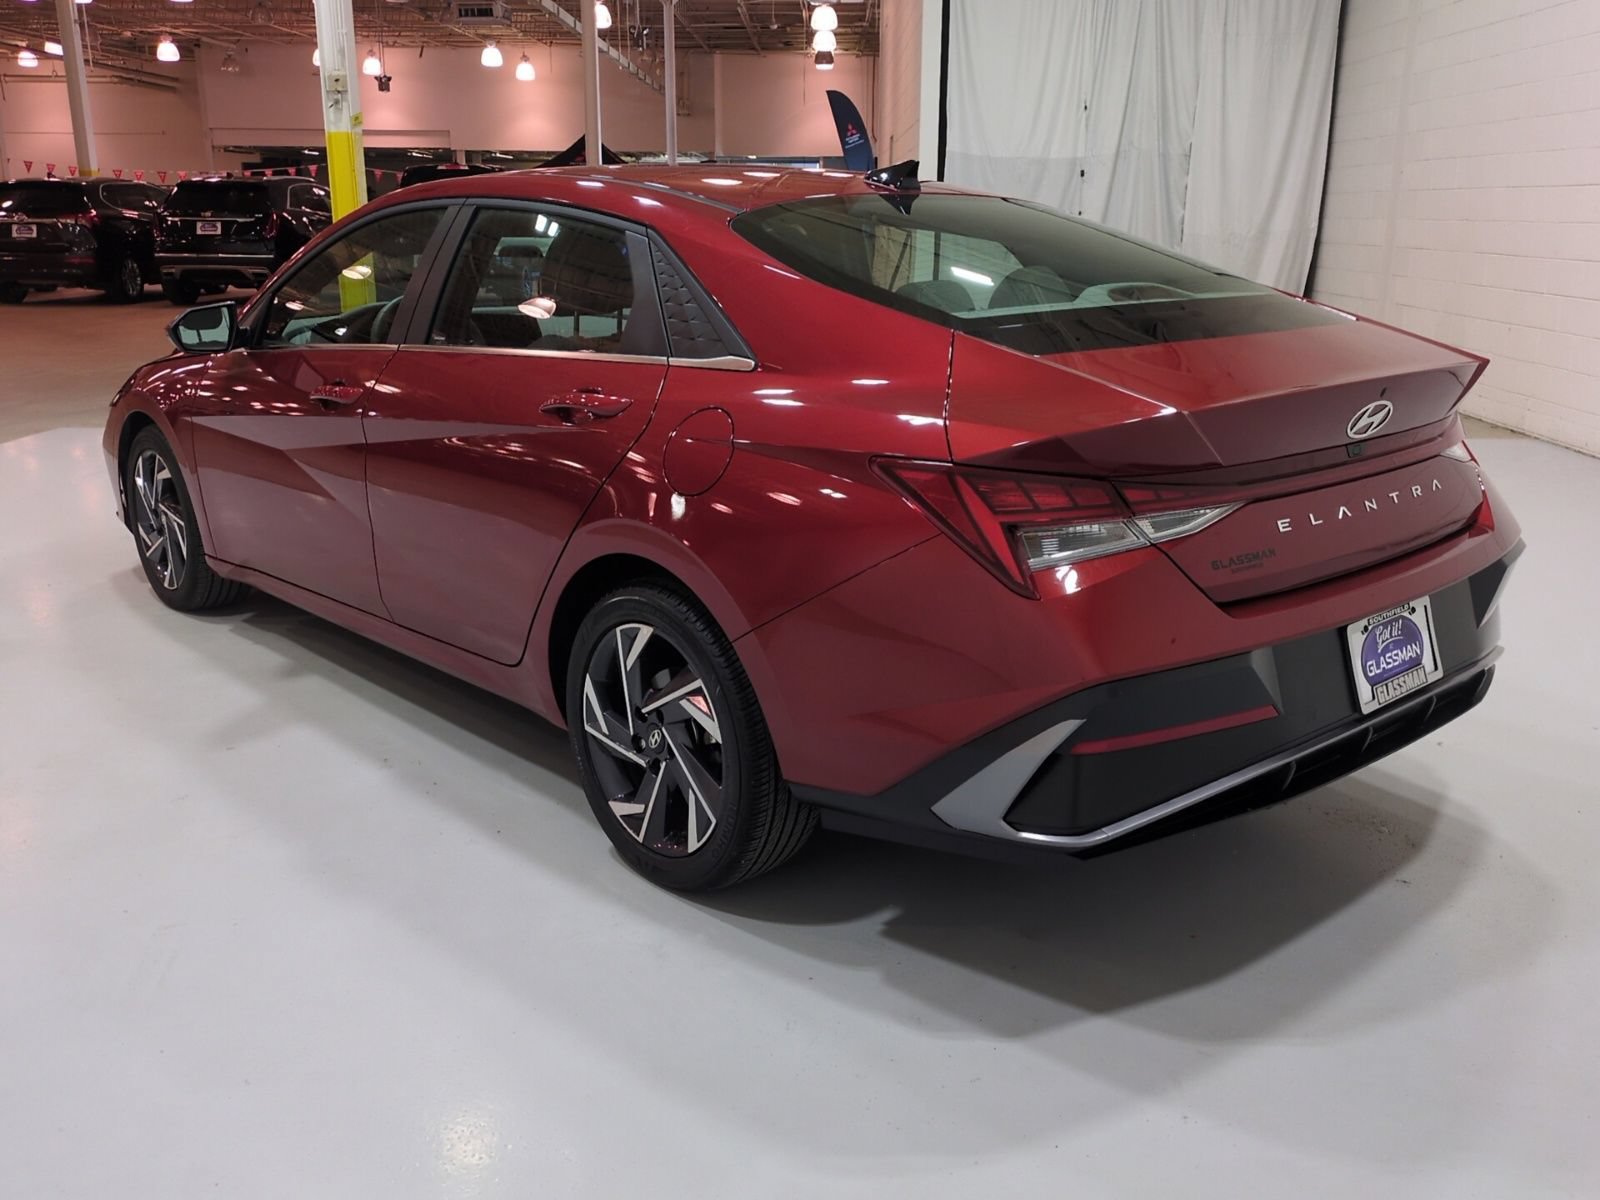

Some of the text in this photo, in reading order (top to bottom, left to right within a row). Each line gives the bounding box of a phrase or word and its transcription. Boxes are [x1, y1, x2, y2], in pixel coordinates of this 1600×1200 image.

[1276, 479, 1442, 533] ELANTRA
[1210, 547, 1277, 570] GLASSMAN
[1369, 604, 1409, 625] SOUTHFIELD
[1375, 619, 1403, 649] Got it!
[1366, 642, 1421, 677] GLASSMAN
[1376, 667, 1426, 704] GLASSMAN
